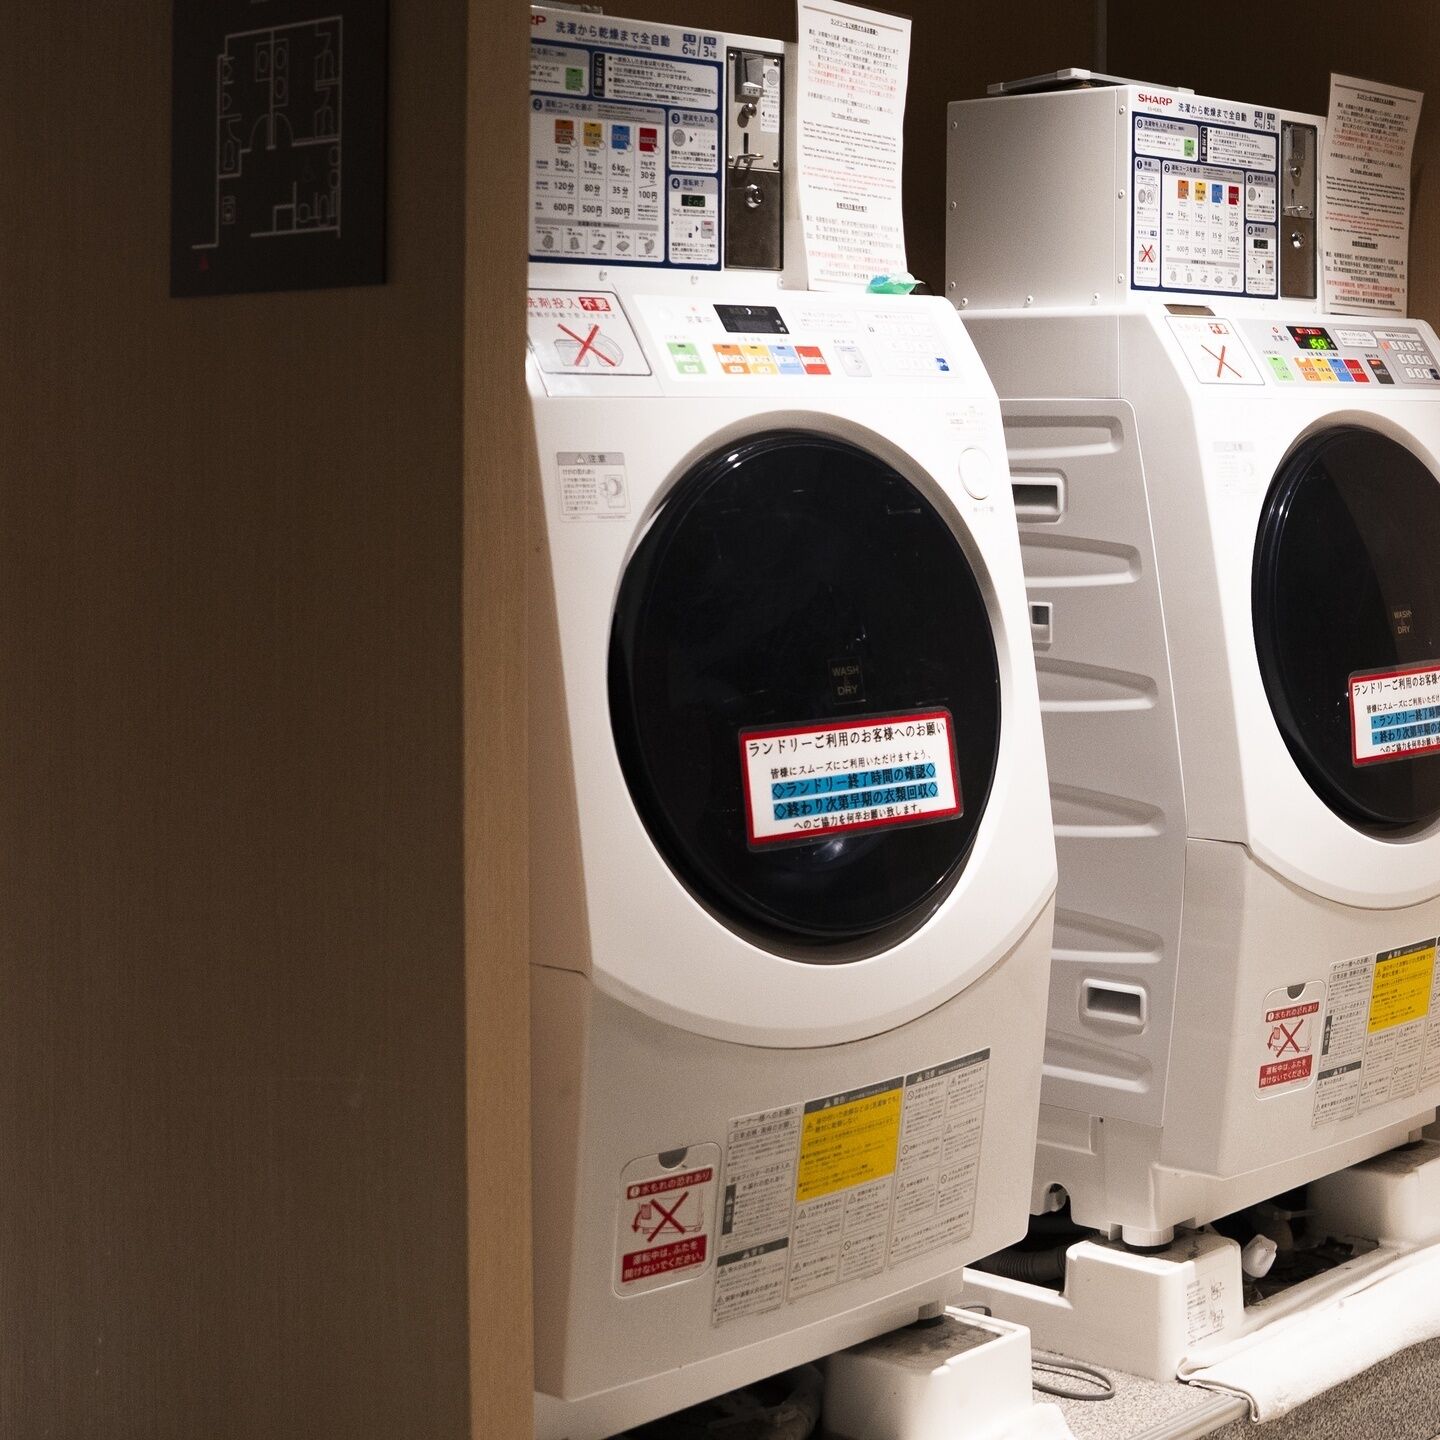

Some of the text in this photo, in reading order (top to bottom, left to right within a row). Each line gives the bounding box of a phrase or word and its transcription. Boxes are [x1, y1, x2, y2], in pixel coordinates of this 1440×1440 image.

[555, 20, 671, 48] 洗濯から乾燥まで全自動
[1137, 93, 1173, 106] SHARP
[1178, 102, 1247, 123] 洗濯から乾燥まで全自動
[1397, 626, 1411, 635] DRY
[832, 665, 860, 677] WASH
[837, 684, 859, 696] DRY
[749, 721, 945, 758] ランドリーご利用のお客様へのお願い
[770, 750, 932, 780] 皆様にスムーズにご利用いただけますよう、
[793, 804, 924, 830] へのご協力を何卒お願い致します。
[640, 1171, 710, 1192] 水もれの恐れあり
[633, 1240, 698, 1266] 運転中は、ふたを
